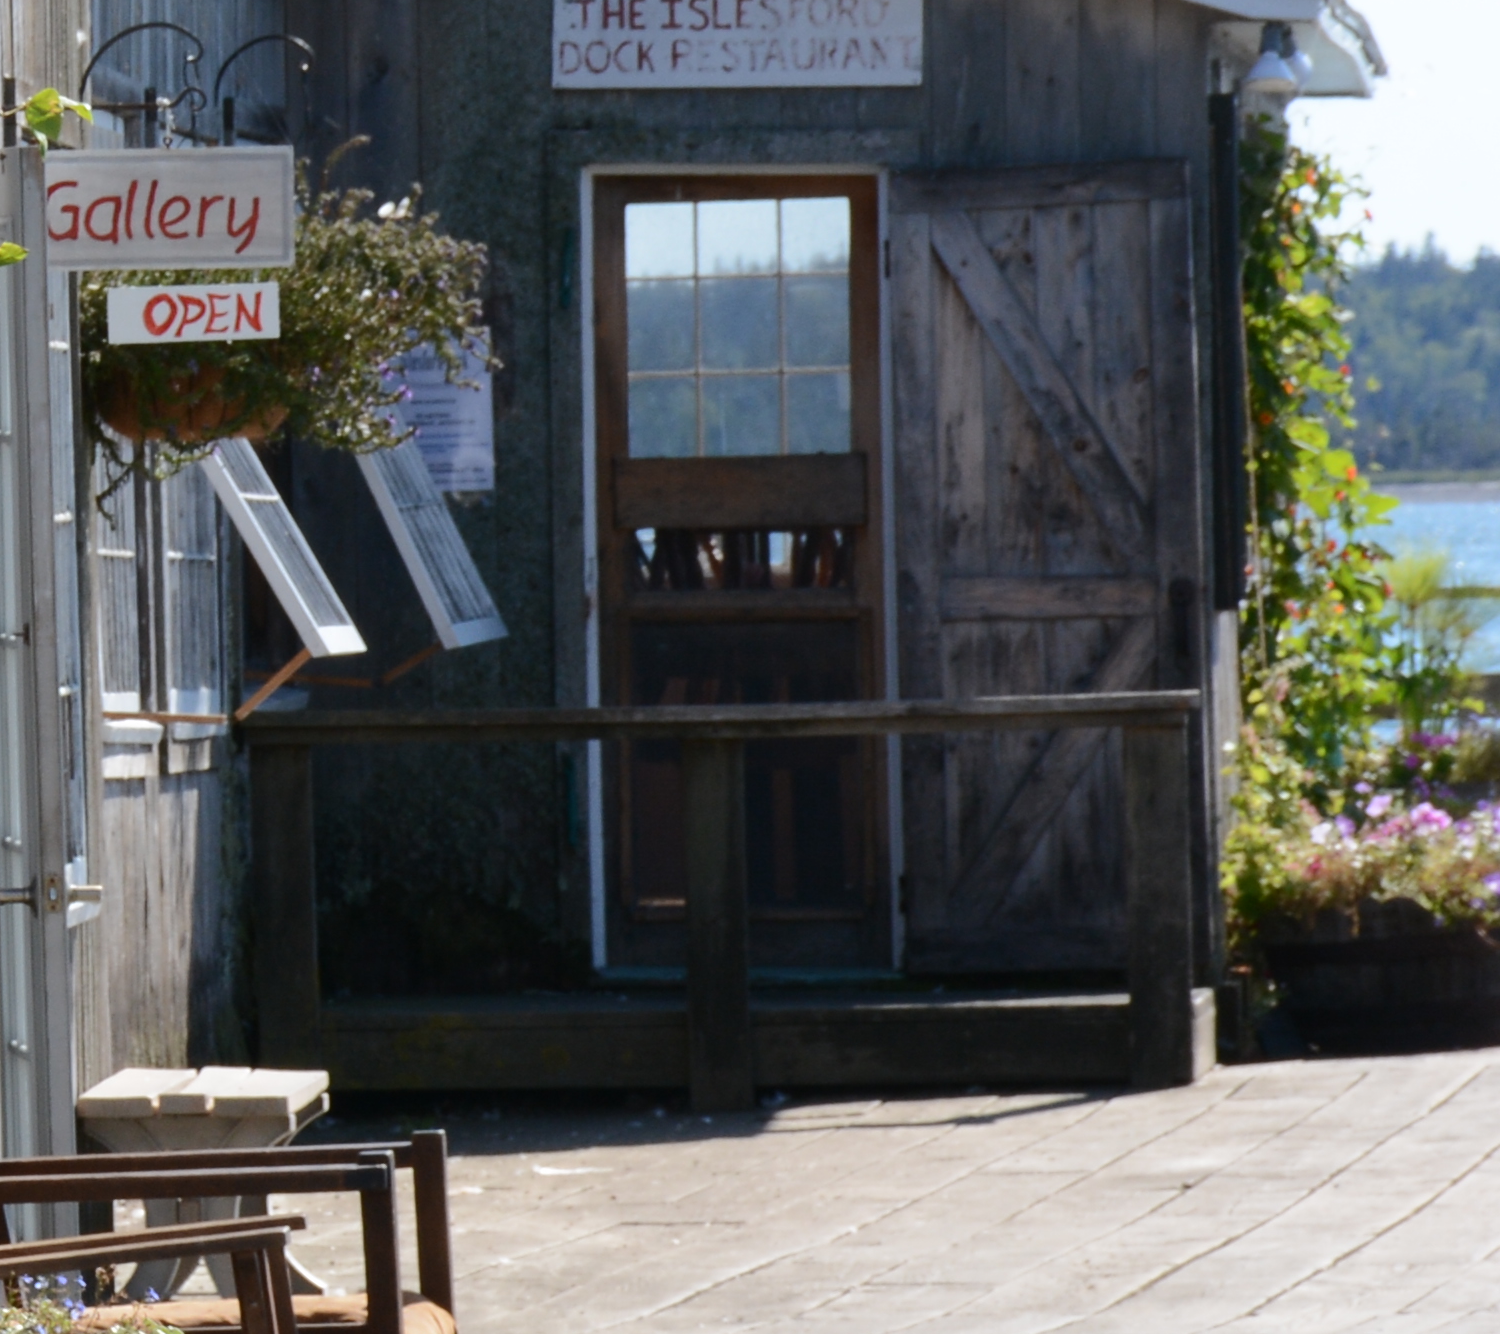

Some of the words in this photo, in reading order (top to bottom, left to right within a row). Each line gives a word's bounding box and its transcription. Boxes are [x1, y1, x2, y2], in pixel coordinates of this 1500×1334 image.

[559, 40, 656, 75] DOCK
[671, 34, 918, 73] RESTAURANT
[47, 179, 261, 254] Gallery
[142, 291, 263, 338] OPEN
